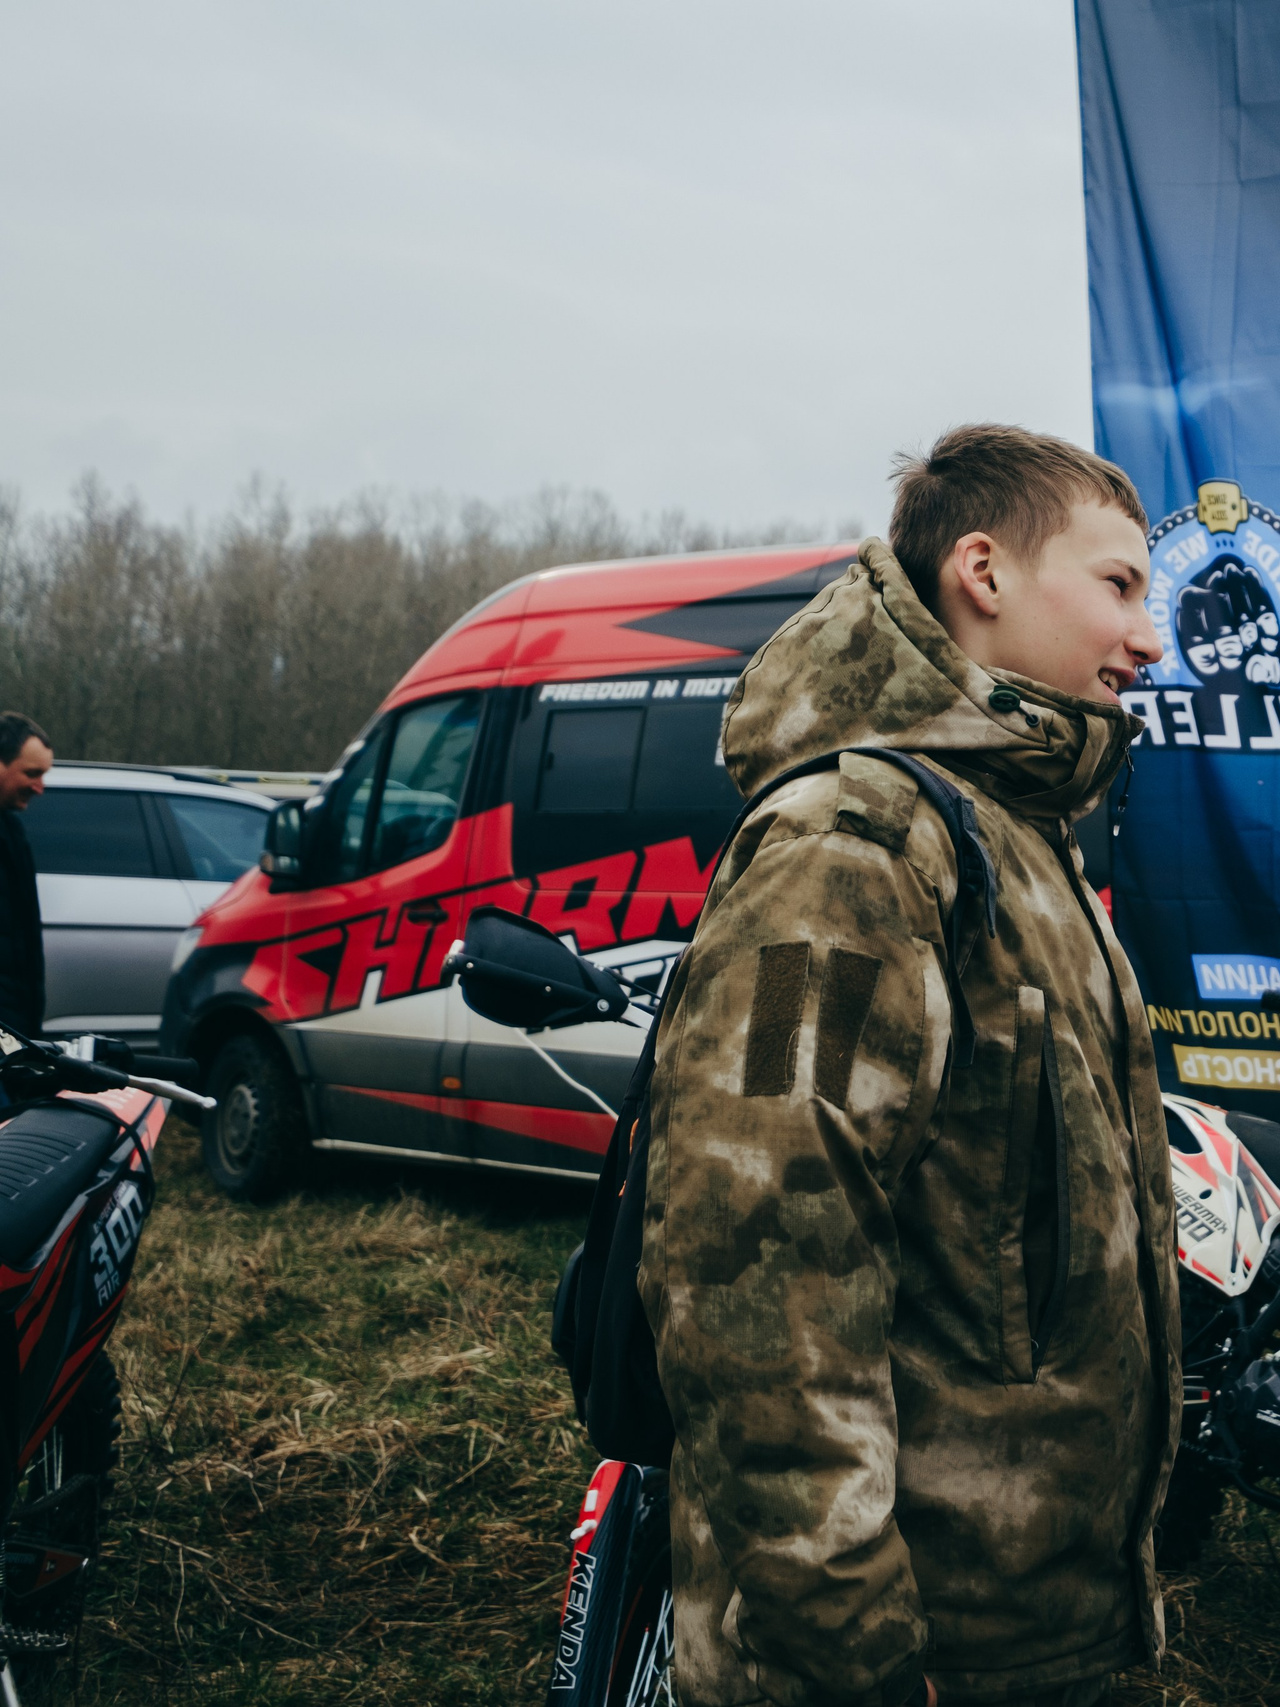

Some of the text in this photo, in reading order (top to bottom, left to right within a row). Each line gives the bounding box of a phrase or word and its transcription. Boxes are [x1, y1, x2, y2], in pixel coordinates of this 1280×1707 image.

[539, 681, 650, 702] FREEDOM
[652, 679, 680, 698] IN
[90, 1184, 144, 1290] 300
[98, 1269, 120, 1307] AIR
[551, 1549, 597, 1690] KENDA
